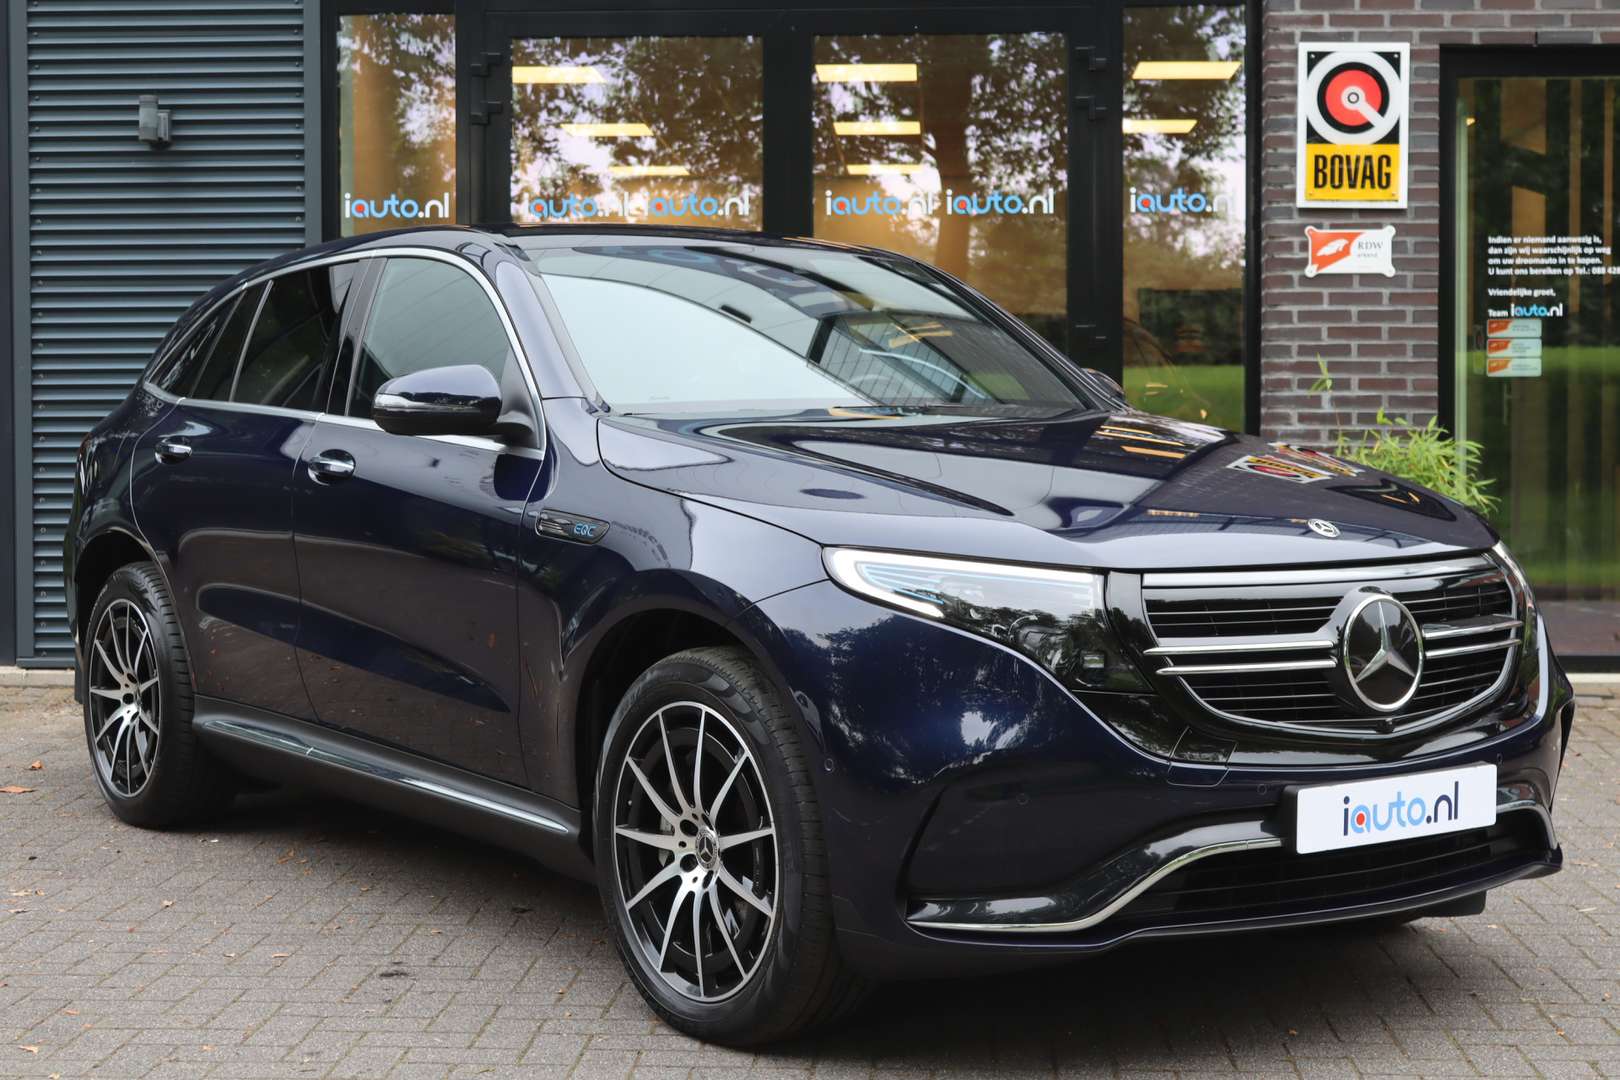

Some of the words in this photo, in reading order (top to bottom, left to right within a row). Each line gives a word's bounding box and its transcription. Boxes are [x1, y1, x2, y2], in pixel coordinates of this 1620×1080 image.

[1313, 154, 1391, 190] BOVAG
[344, 192, 450, 219] iauto.nl
[640, 190, 750, 217] iauto.nl
[825, 189, 933, 216] iauto.nl
[946, 188, 1055, 215] iauto.nl
[1129, 186, 1237, 213] iauto.n
[1358, 240, 1383, 250] RDW
[1488, 236, 1512, 244] Indien
[1523, 236, 1556, 244] niemand
[1557, 236, 1592, 245] aanwezig
[1488, 246, 1503, 254] dan
[1504, 246, 1517, 255] zijn
[1518, 246, 1530, 255] wij
[1532, 246, 1582, 255] waarschijnlijk
[1583, 247, 1594, 255] op
[1595, 247, 1611, 255] weg
[1515, 257, 1557, 265] droomauto
[1558, 256, 1567, 265] in
[1567, 257, 1576, 265] te
[1488, 267, 1495, 275] U
[1496, 267, 1513, 275] kunt
[1529, 267, 1562, 275] bereiken
[1563, 268, 1574, 276] op
[1488, 288, 1532, 297] Vriendelijke
[1488, 309, 1508, 317] Team
[1511, 302, 1563, 317] iauto.nl
[574, 523, 597, 537] EQC
[1343, 780, 1459, 836] iauto.nl
